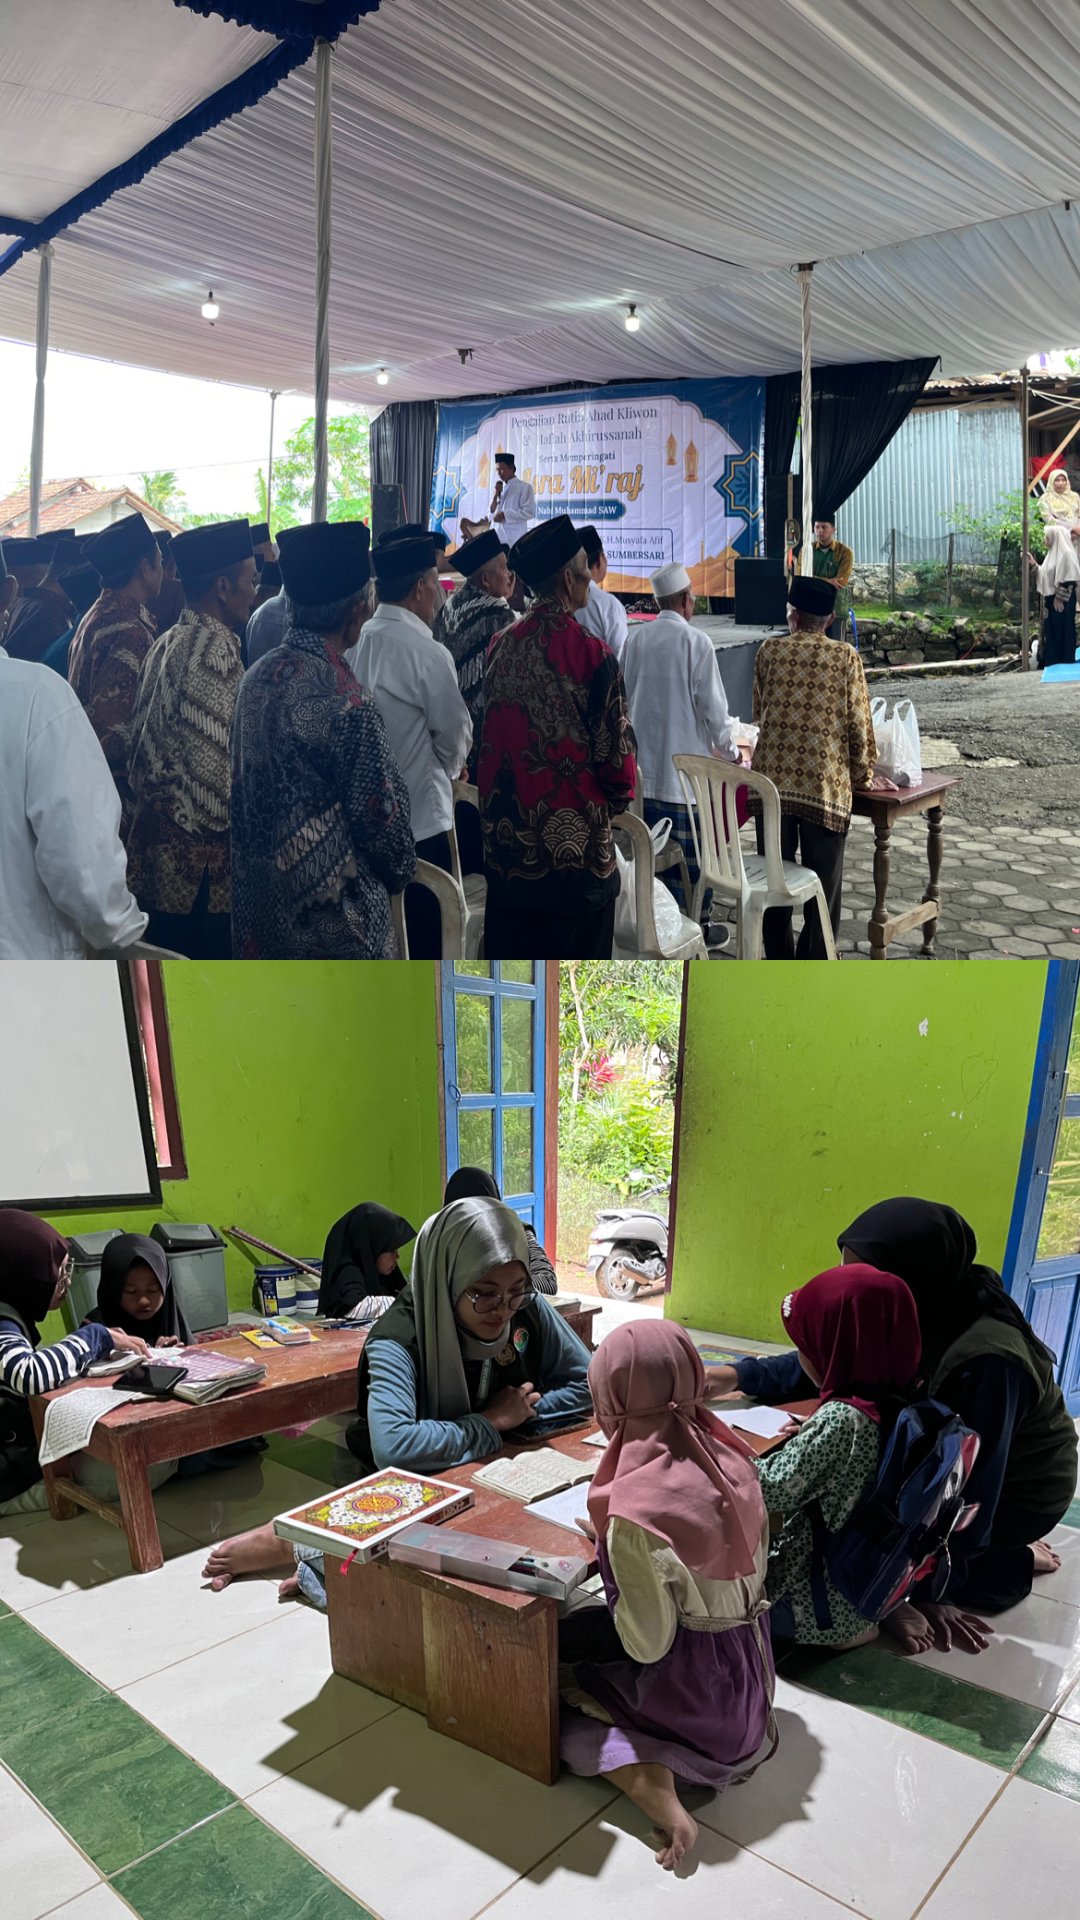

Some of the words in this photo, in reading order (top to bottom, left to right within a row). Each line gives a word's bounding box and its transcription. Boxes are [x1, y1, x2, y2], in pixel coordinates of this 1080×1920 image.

[511, 414, 555, 429] Pengajian
[587, 408, 614, 421] Ahad
[617, 406, 658, 420] Kliwon
[570, 426, 642, 443] Akhirussanah
[539, 454, 558, 463] Serta
[560, 451, 616, 463] Memperingati
[538, 506, 553, 515] Nabi
[555, 505, 597, 515] Muhammad
[598, 505, 617, 515] SAW
[607, 550, 665, 560] SUMBERSARI
